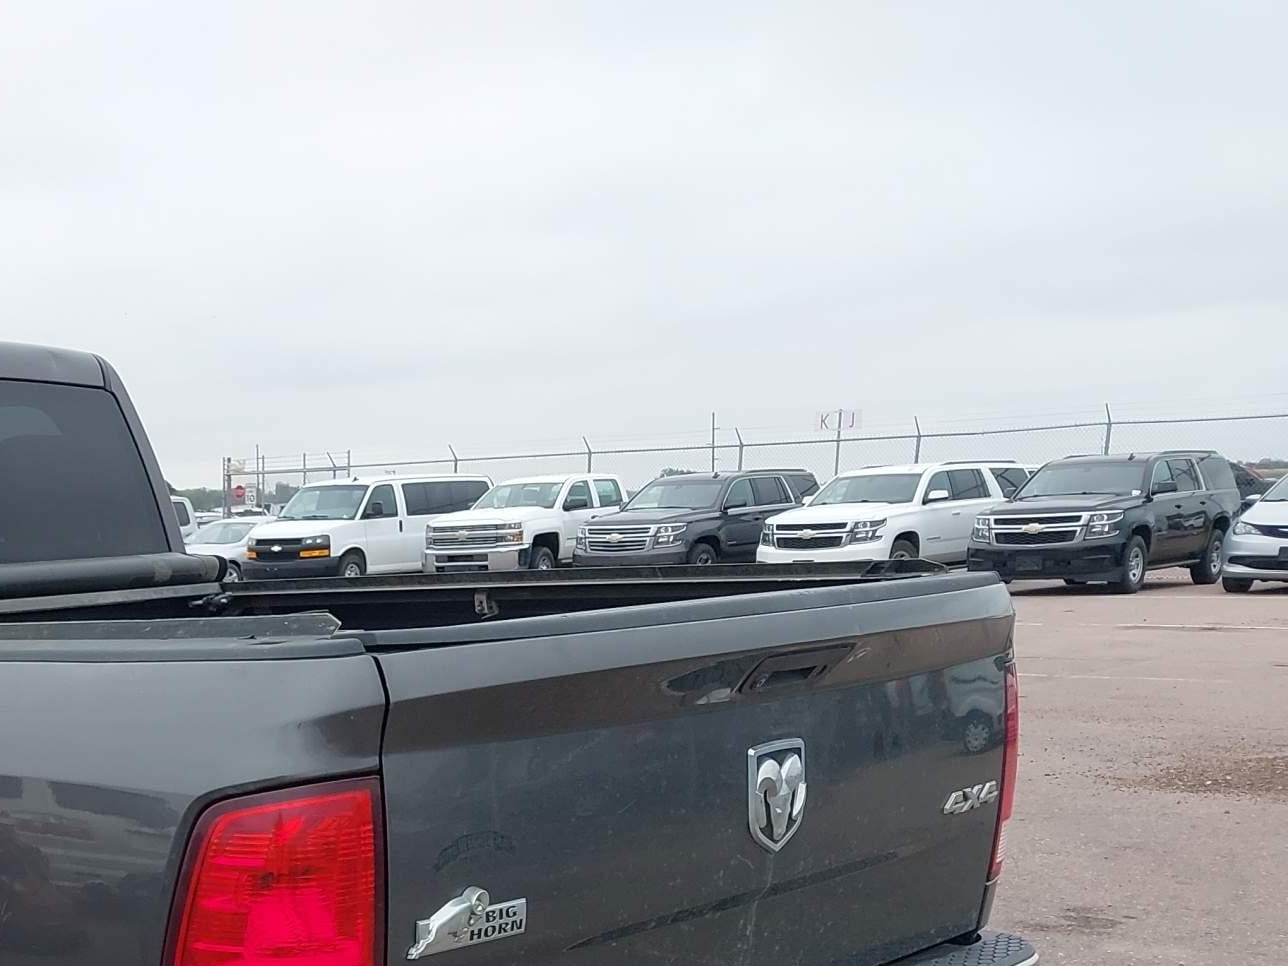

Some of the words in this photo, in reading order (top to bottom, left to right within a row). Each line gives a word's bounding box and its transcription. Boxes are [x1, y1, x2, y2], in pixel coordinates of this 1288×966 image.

[820, 413, 830, 430] K
[485, 905, 518, 923] BIG
[469, 918, 523, 941] HORN
